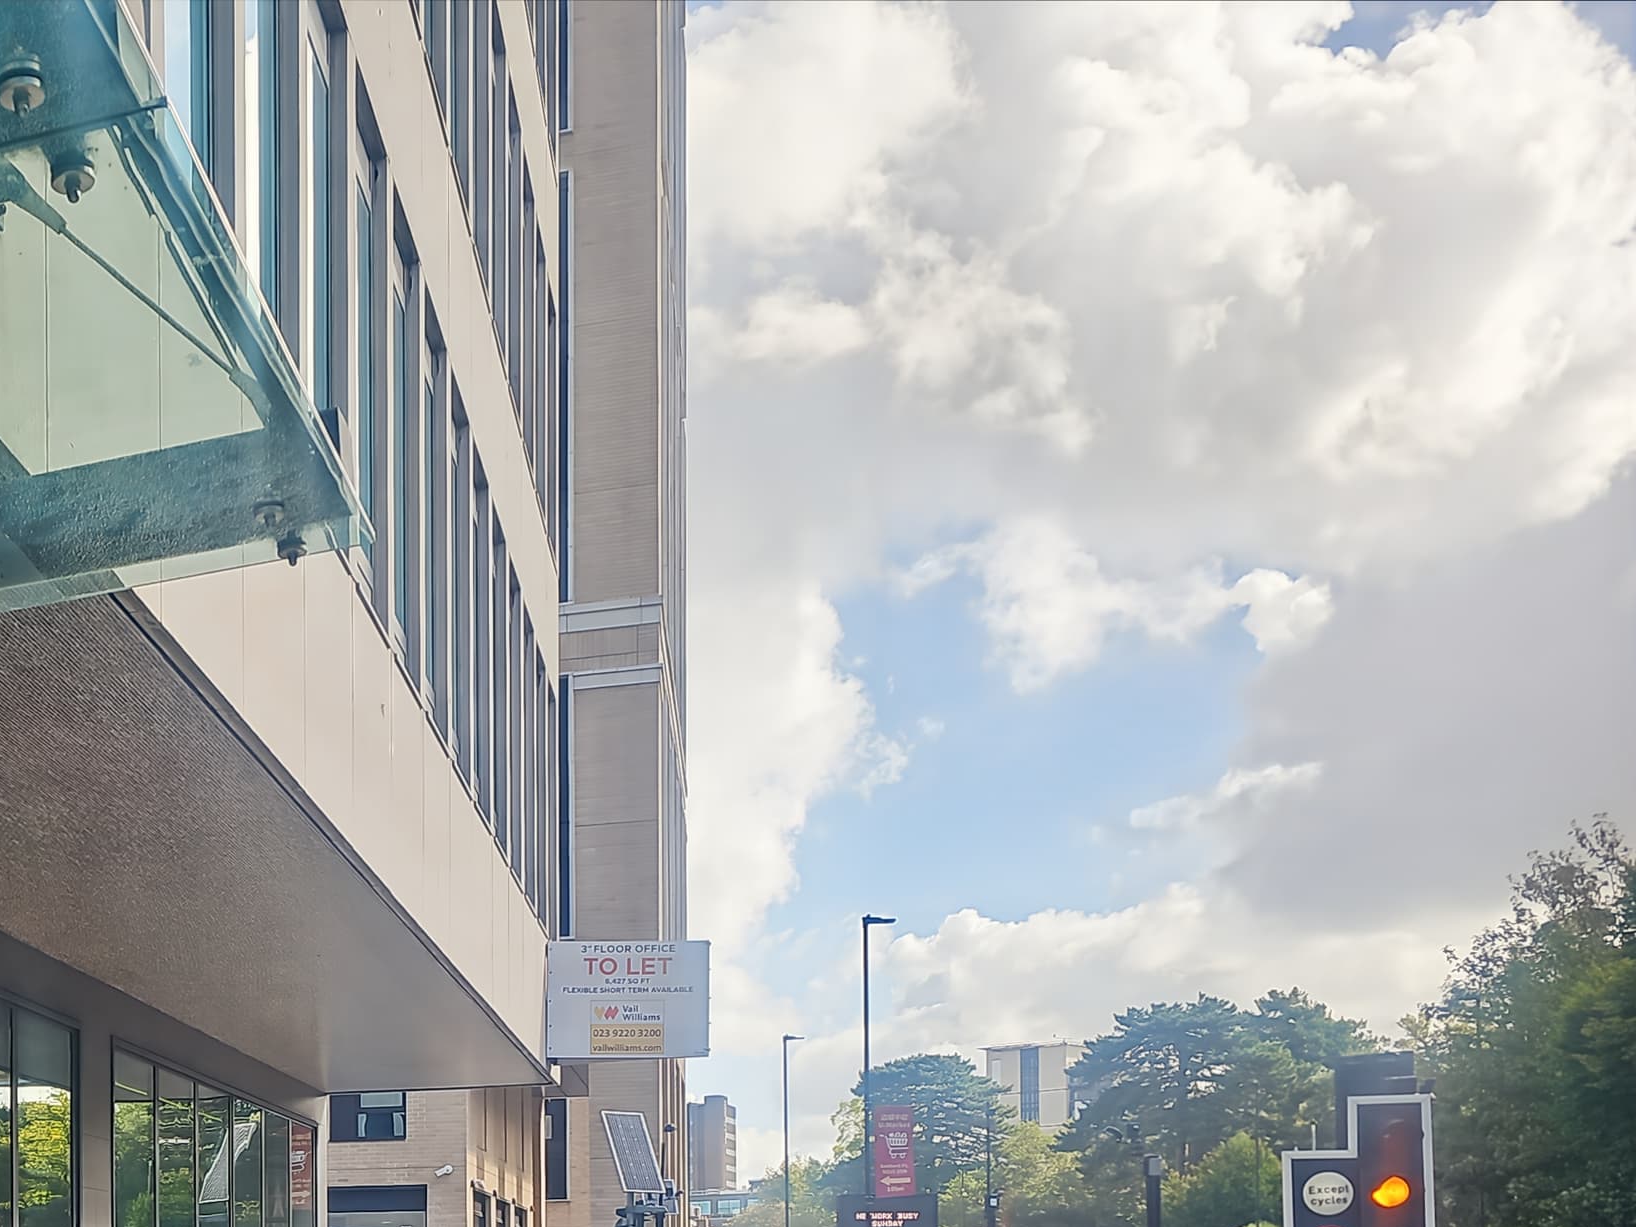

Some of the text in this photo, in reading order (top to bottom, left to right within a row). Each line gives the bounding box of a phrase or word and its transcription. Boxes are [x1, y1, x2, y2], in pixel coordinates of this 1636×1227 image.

[594, 945, 632, 953] FLOOR
[635, 944, 676, 953] OFFICE
[583, 957, 673, 976] TO LET
[622, 1005, 639, 1013] Vail
[622, 1013, 661, 1021] Williams
[593, 1029, 662, 1038] 023 9220 3200
[592, 1044, 662, 1052] vailwilliams.com
[1308, 1184, 1350, 1195] Except
[1310, 1196, 1348, 1207] cycles
